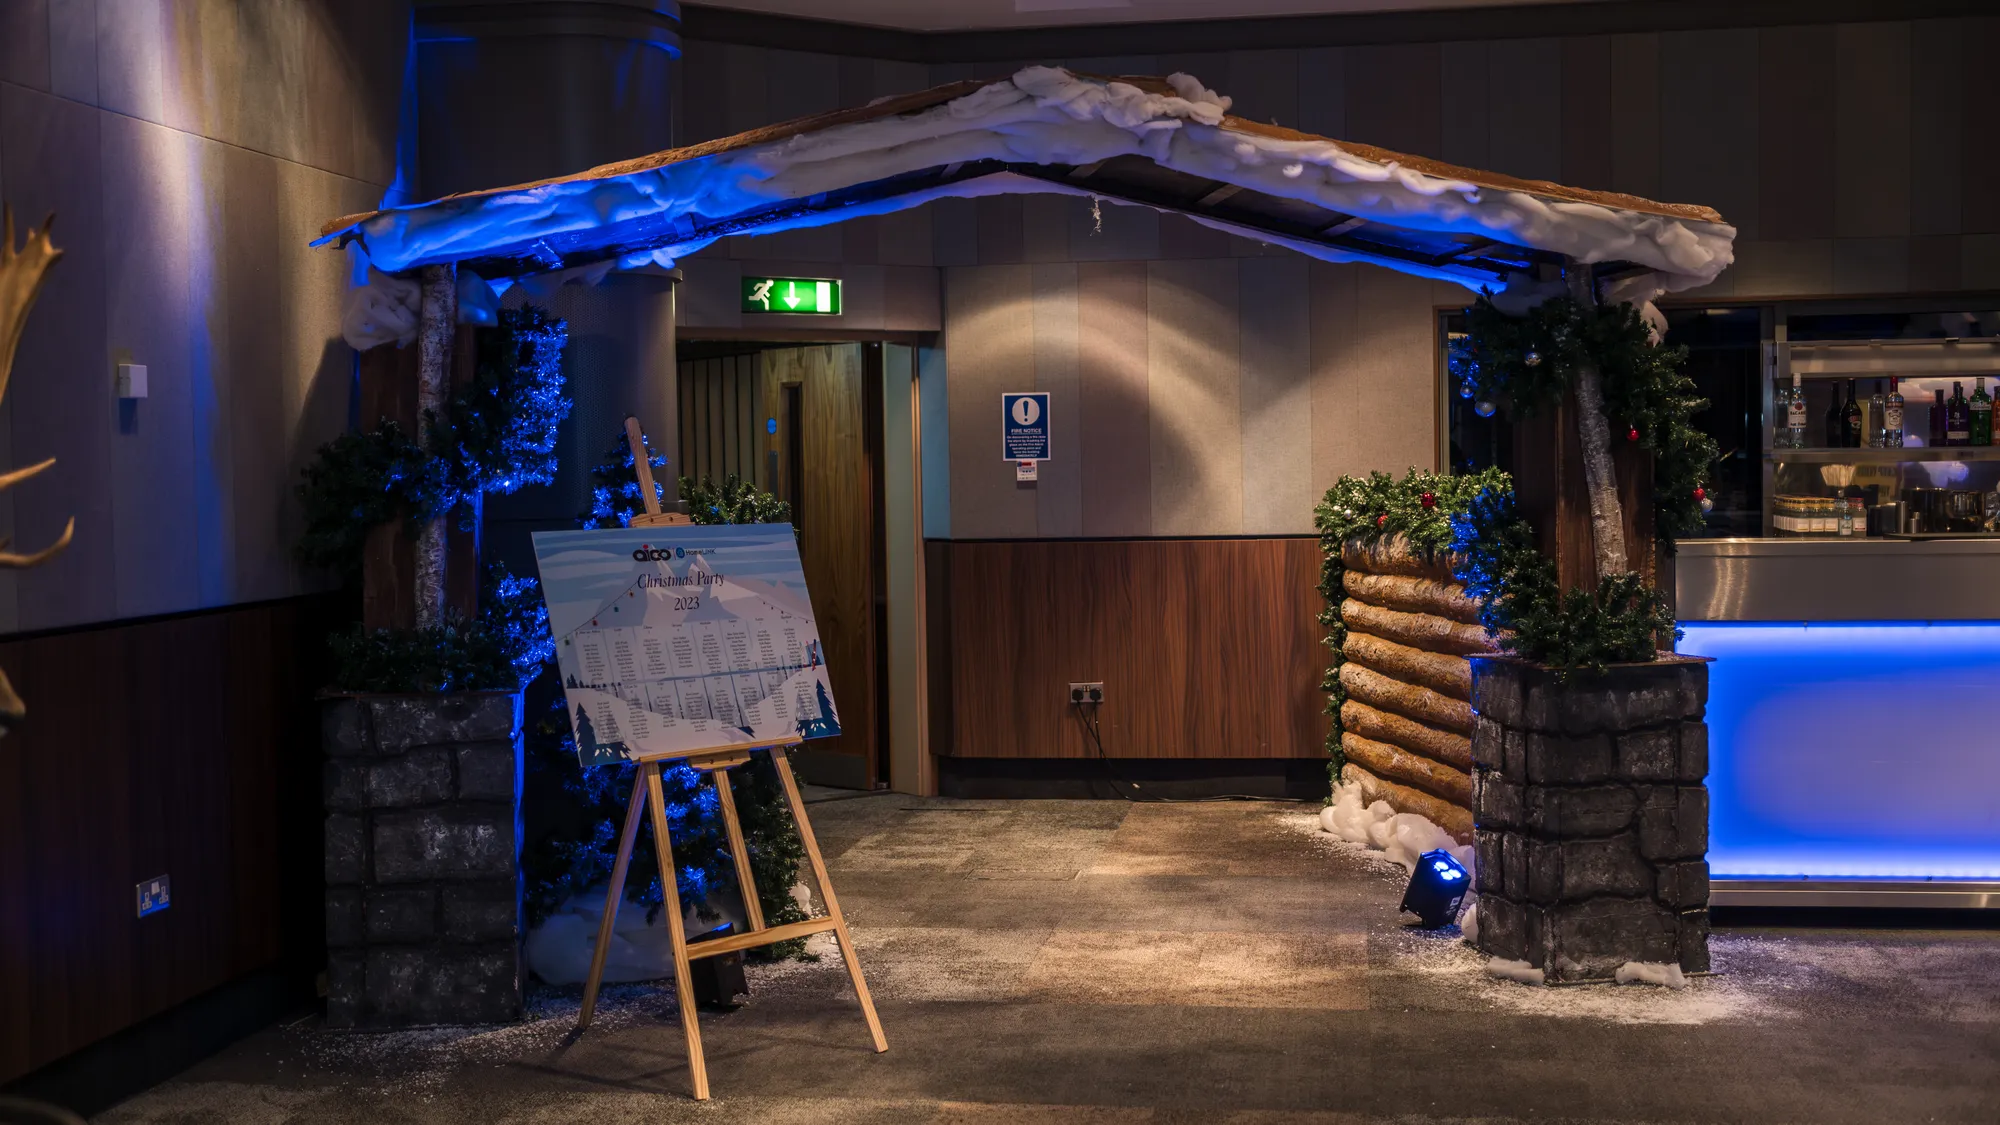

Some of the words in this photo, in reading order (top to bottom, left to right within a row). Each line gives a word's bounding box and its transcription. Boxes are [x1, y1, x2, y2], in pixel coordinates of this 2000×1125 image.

[633, 544, 671, 562] aico
[637, 573, 694, 589] Christmas
[697, 570, 725, 586] Party
[674, 596, 700, 611] 2023
